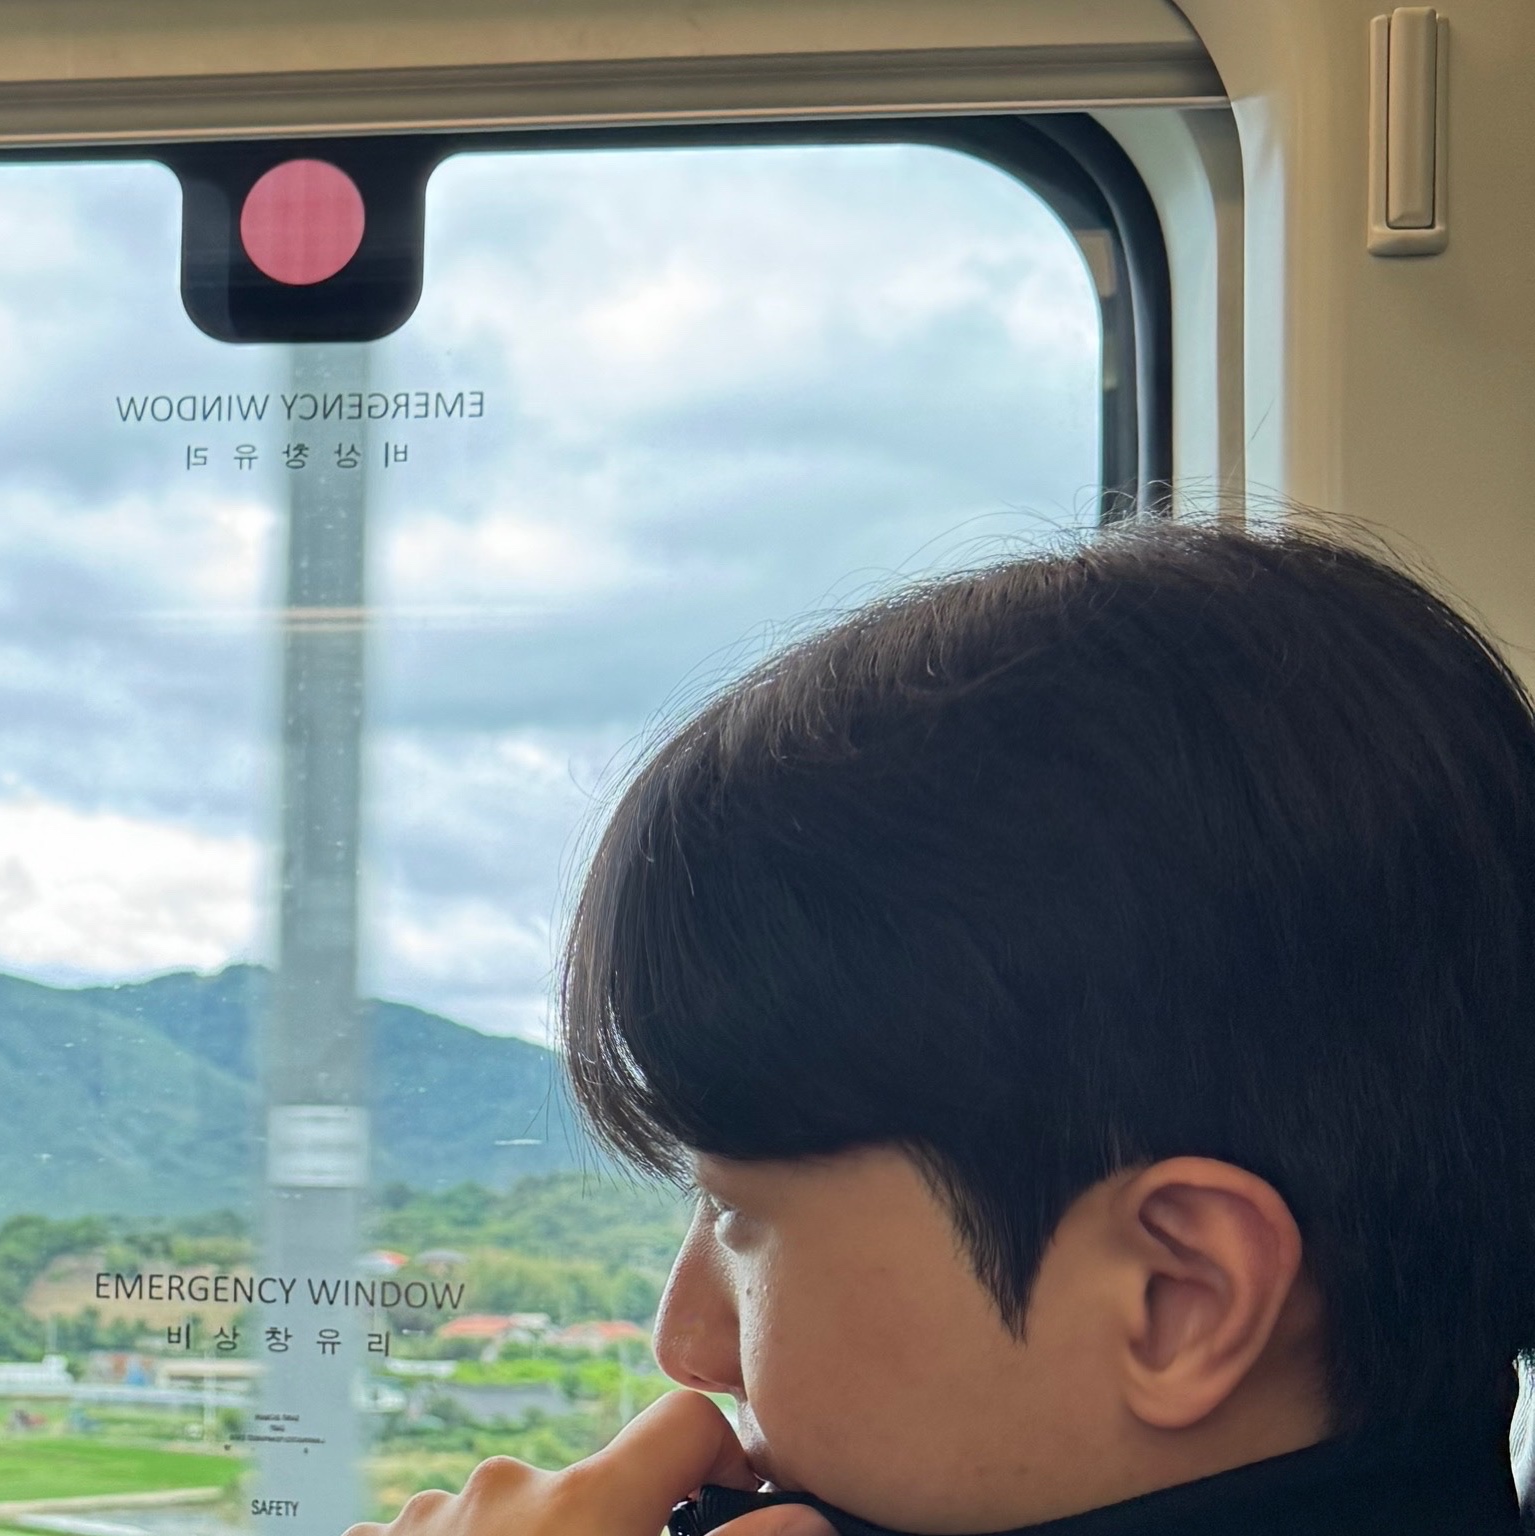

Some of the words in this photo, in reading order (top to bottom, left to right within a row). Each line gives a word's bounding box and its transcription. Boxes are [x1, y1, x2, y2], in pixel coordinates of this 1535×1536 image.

[95, 1272, 297, 1305] EMERGENCY
[308, 1278, 465, 1310] WINDOW
[251, 1499, 300, 1517] SAFETY
